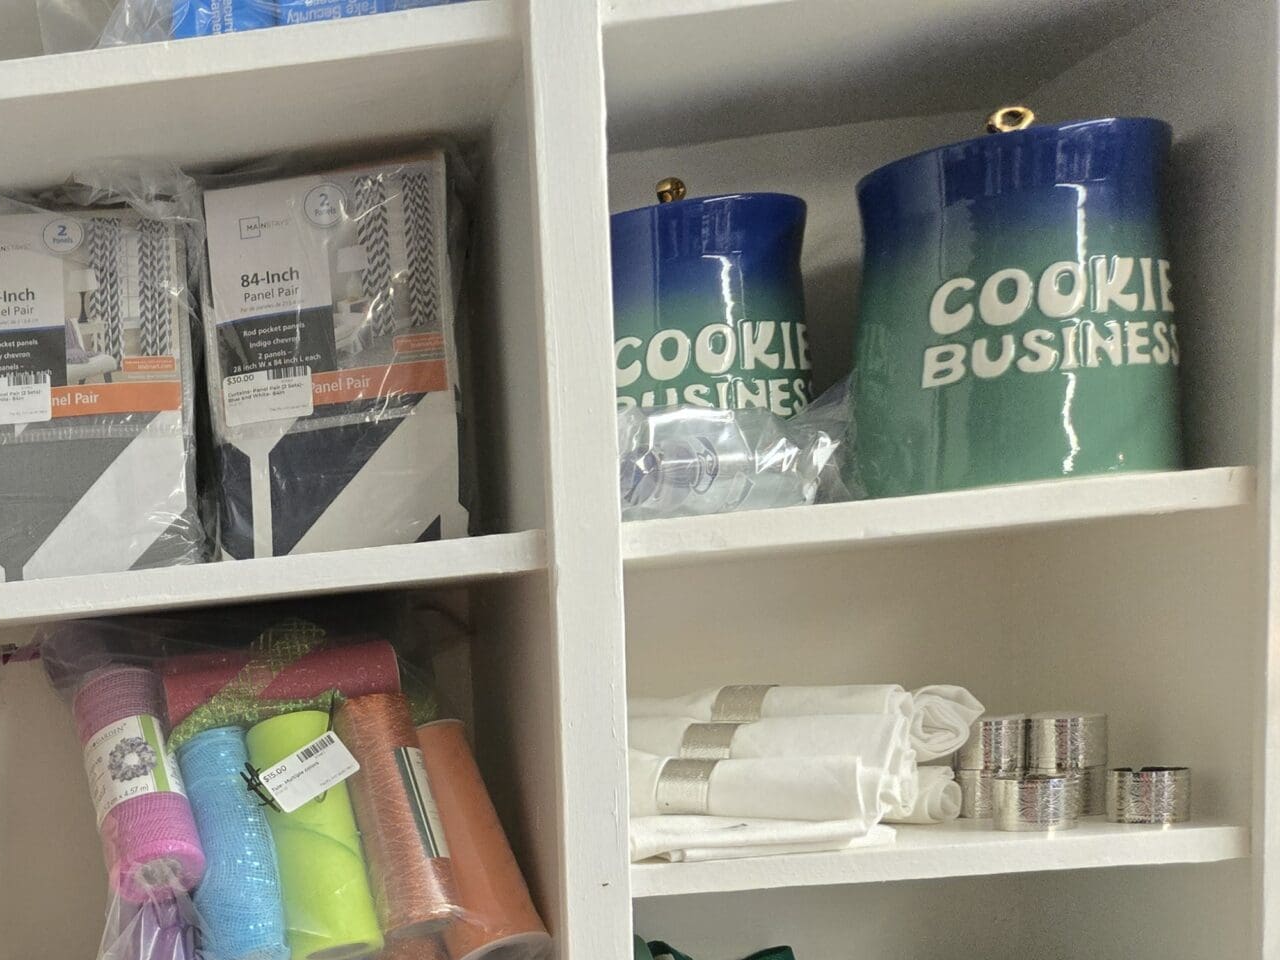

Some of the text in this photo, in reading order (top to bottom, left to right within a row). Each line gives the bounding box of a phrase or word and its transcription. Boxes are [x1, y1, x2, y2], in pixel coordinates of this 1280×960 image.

[345, 1, 378, 17] Fake
[319, 193, 329, 206] 2
[57, 225, 67, 236] 2
[240, 266, 299, 287] 84-Inch
[244, 285, 299, 302] Panel Pair
[928, 256, 1176, 336] COOKIE
[14, 305, 34, 316] Pair
[17, 338, 38, 347] panels
[614, 319, 812, 388] COOKIE
[921, 318, 1181, 389] BUSINESS
[227, 373, 254, 385] $30.00
[346, 377, 370, 391] Pair
[52, 391, 100, 406] nel Pair
[616, 378, 812, 416] USINES
[263, 764, 288, 784] $15.00
